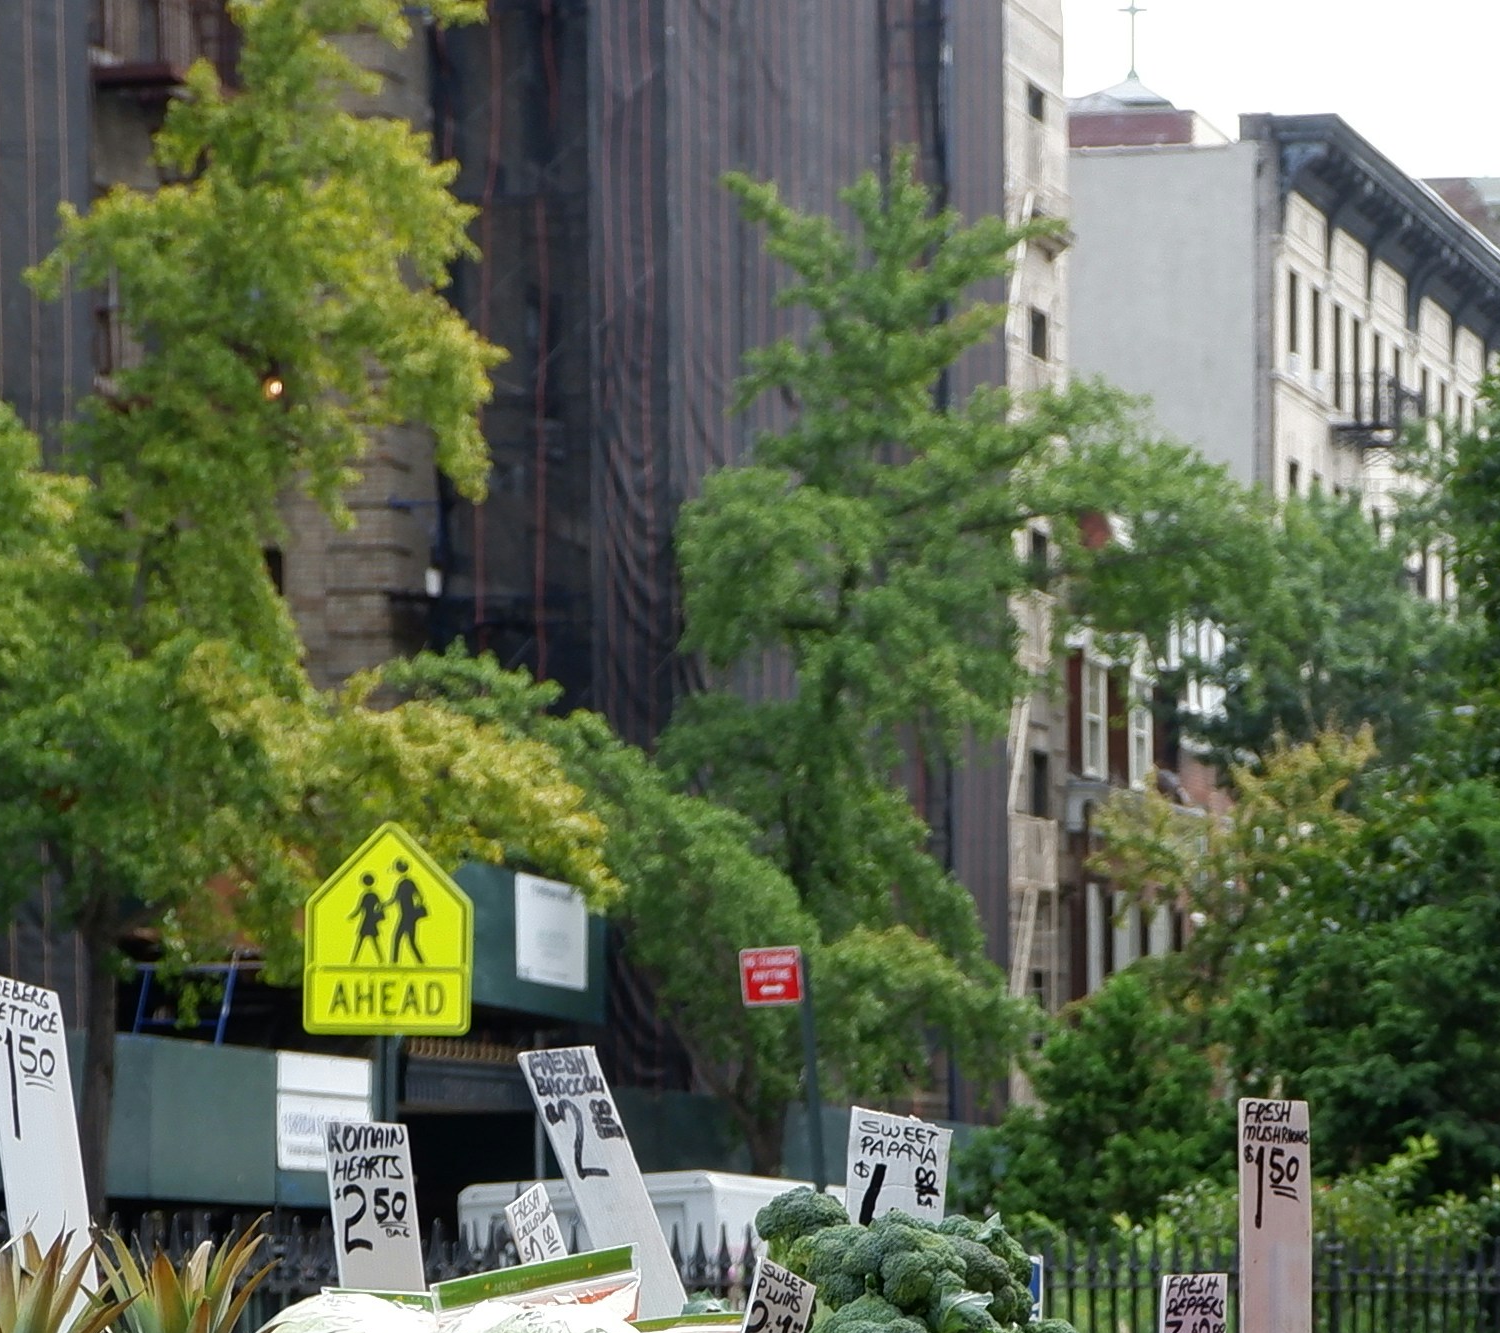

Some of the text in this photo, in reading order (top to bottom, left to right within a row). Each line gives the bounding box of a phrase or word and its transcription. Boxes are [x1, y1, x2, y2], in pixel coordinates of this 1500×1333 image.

[328, 980, 447, 1017] AHEAD
[1244, 1100, 1293, 1123] FRESH
[858, 1119, 941, 1146] SWEET
[860, 1136, 938, 1168] PAPAYA
[332, 1156, 405, 1182] HEARTS
[1167, 1276, 1220, 1298] FRESH
[1166, 1296, 1224, 1320] PEPPERS
